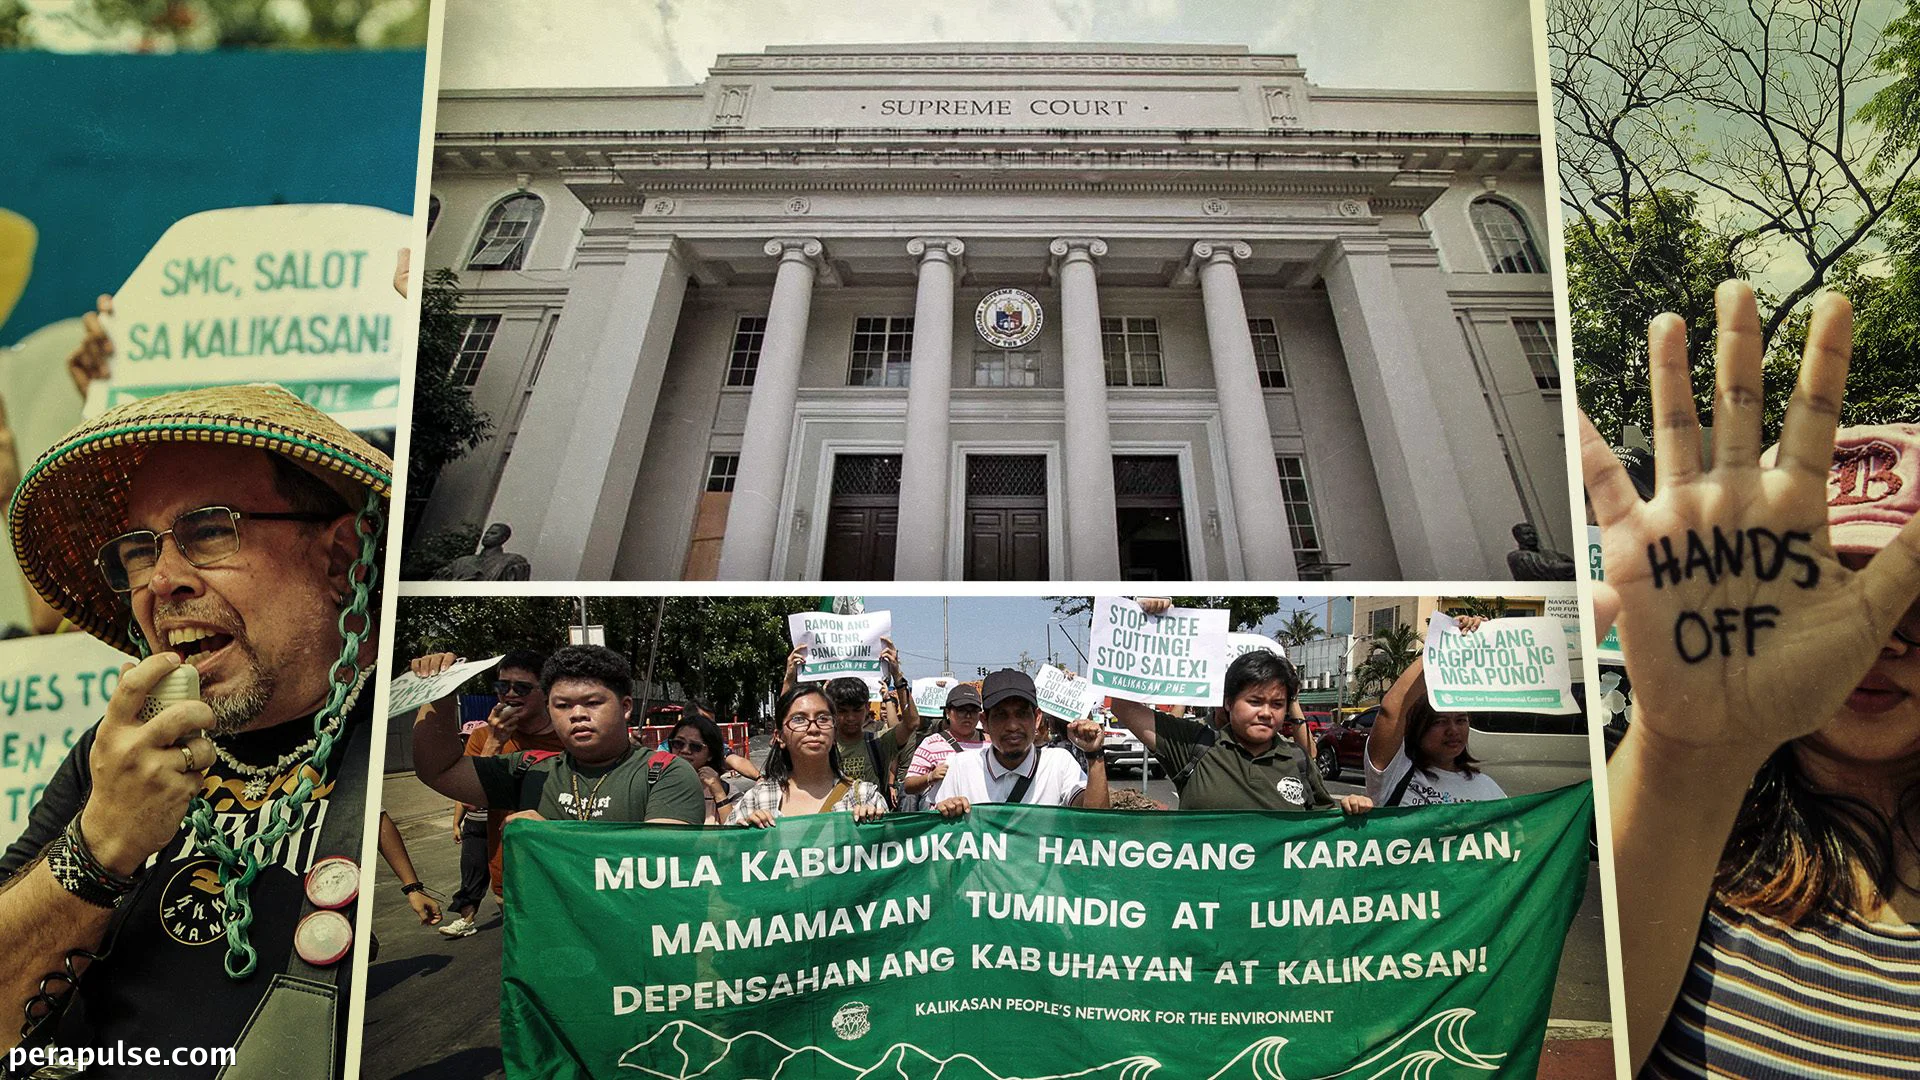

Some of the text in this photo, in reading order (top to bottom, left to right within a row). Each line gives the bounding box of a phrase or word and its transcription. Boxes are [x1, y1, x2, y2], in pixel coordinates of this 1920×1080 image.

[880, 99, 1127, 116] SUPREME COURT
[160, 250, 368, 299] SMC, SALOT
[128, 313, 392, 361] SA KALIKASAN!
[1647, 525, 1820, 589] HANDS
[805, 619, 870, 631] RAMON ANG
[1110, 604, 1199, 636] STOP TREE
[1675, 605, 1781, 664] OFF
[811, 645, 871, 660] PANAGUTIN!
[815, 633, 863, 645] AT DENR,
[1113, 628, 1190, 657] CUTTING!
[1495, 629, 1535, 650] ANG
[818, 663, 853, 672] KALIKASAN
[1097, 646, 1207, 679] STOP SALEX!
[1428, 646, 1555, 668] PAGPUTOL NG
[1112, 675, 1185, 693] KALIKASAN PNE
[1440, 665, 1546, 686] MGA PUNO!
[2, 672, 65, 716] YES
[594, 831, 1521, 890] MULA KABUNDUKAN HANGGANG KARAGATAN,
[651, 890, 1442, 957] MAMAMAYAN TUMINDIG AT LUMABAN!
[613, 957, 870, 1016] DEPENSAHAN
[880, 947, 955, 980] ANG
[1214, 960, 1260, 985] AT
[1278, 946, 1488, 985] KALIKASAN!
[915, 998, 1334, 1025] KALIKASAN PEOPLE'S NETWORK FOR THE ENVIRONMENT
